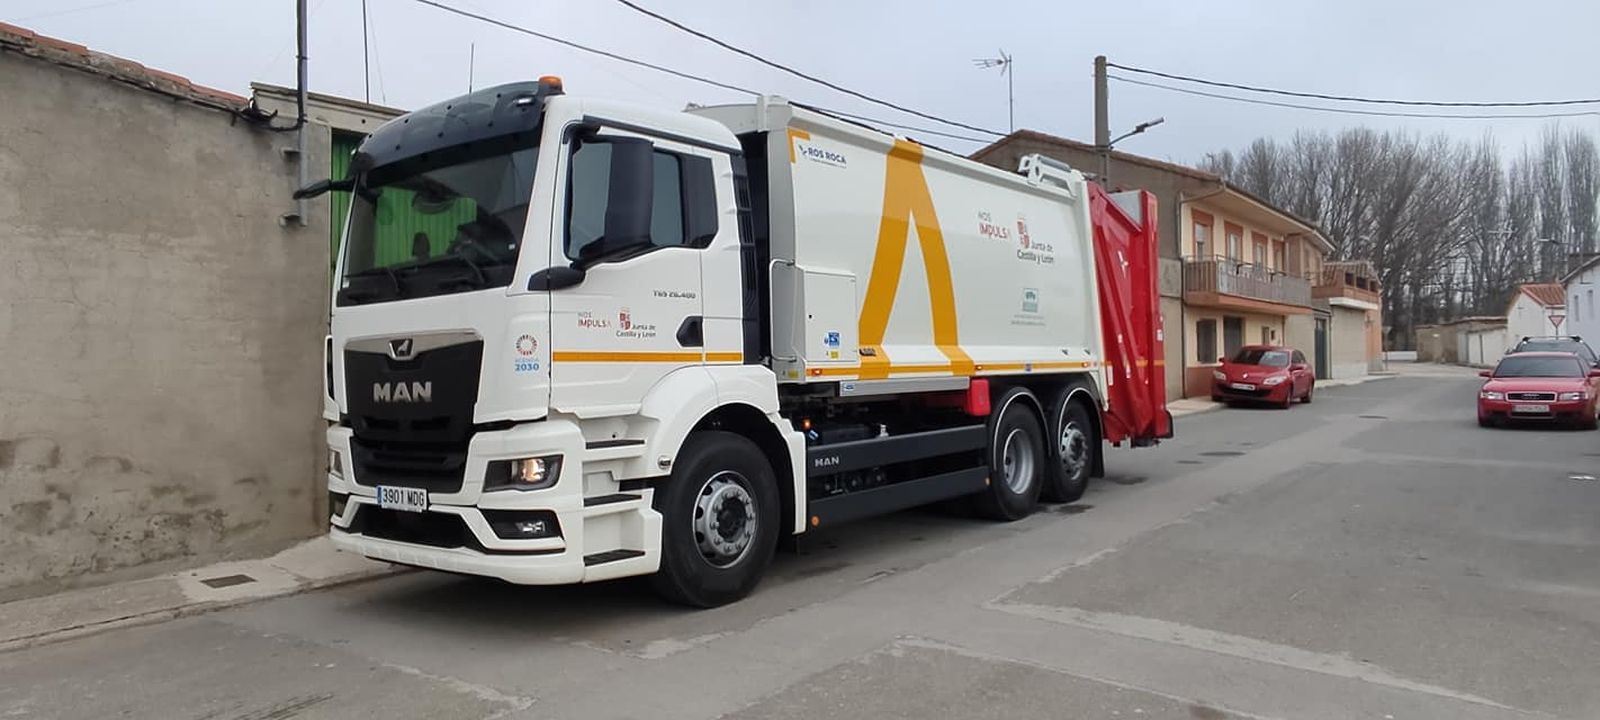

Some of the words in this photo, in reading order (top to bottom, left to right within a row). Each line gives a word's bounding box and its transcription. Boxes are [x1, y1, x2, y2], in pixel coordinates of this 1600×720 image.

[807, 147, 825, 159] ROS
[825, 151, 847, 165] ROCA
[514, 363, 540, 372] 2030
[373, 381, 432, 402] MAN
[814, 456, 840, 467] MAN
[382, 488, 405, 504] 3901
[407, 492, 425, 507] MDG
